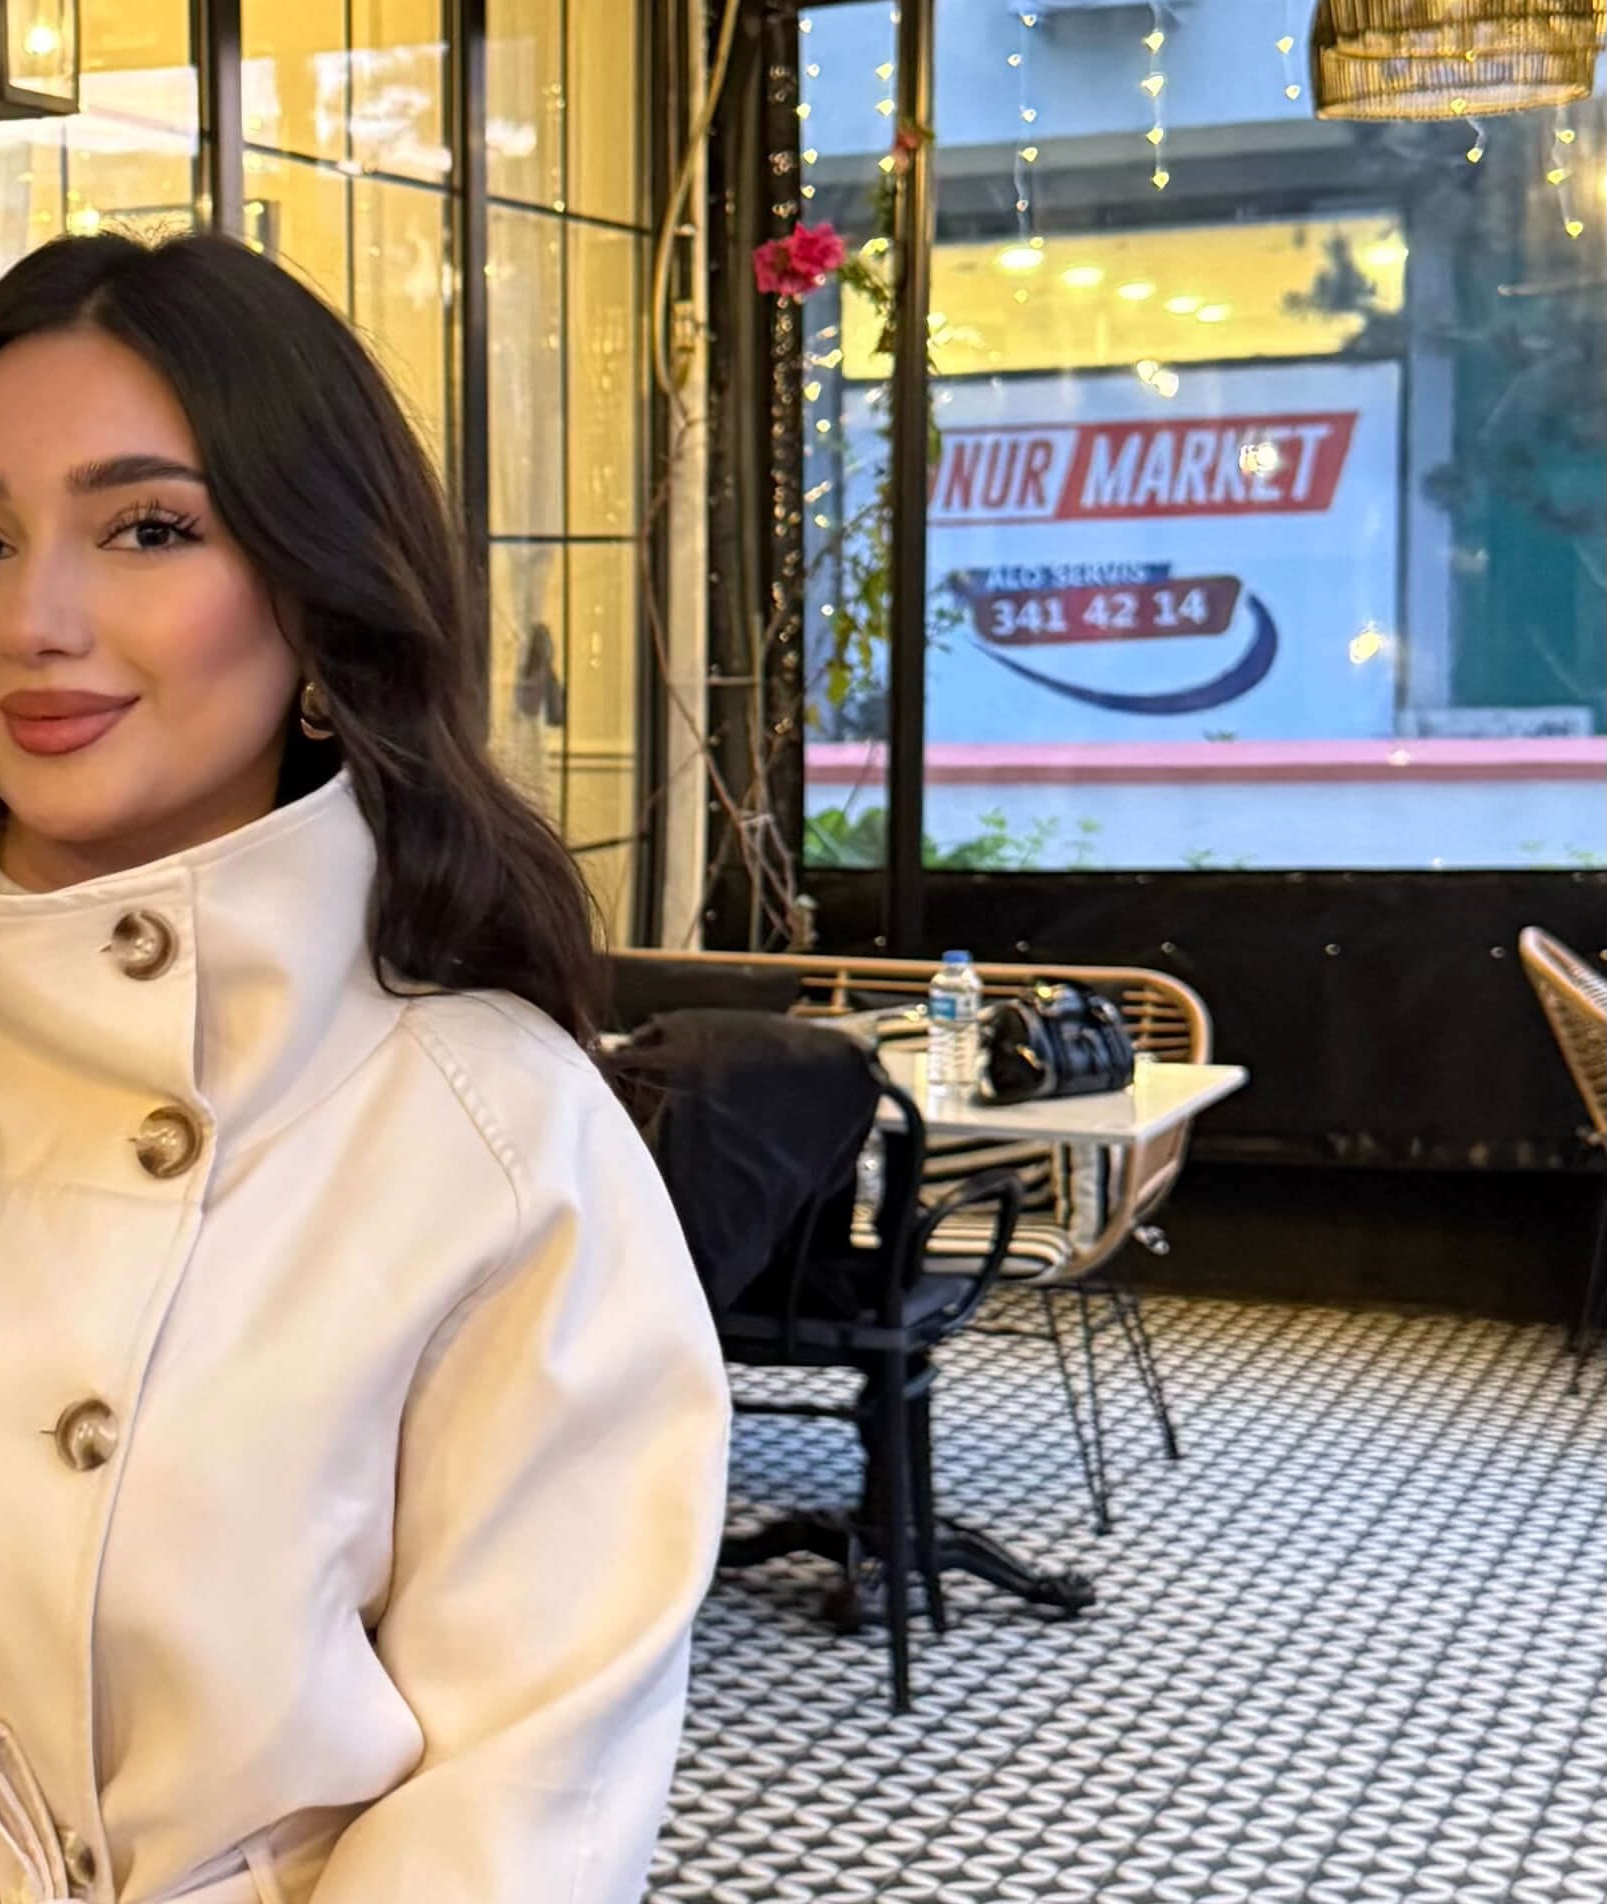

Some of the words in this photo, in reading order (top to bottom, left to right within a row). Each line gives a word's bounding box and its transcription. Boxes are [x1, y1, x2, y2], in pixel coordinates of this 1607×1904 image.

[943, 439, 1053, 510] NUR
[1081, 424, 1333, 508] MARKET
[992, 598, 1068, 637] 341
[1082, 592, 1139, 629] 42
[1152, 589, 1209, 626] 14
